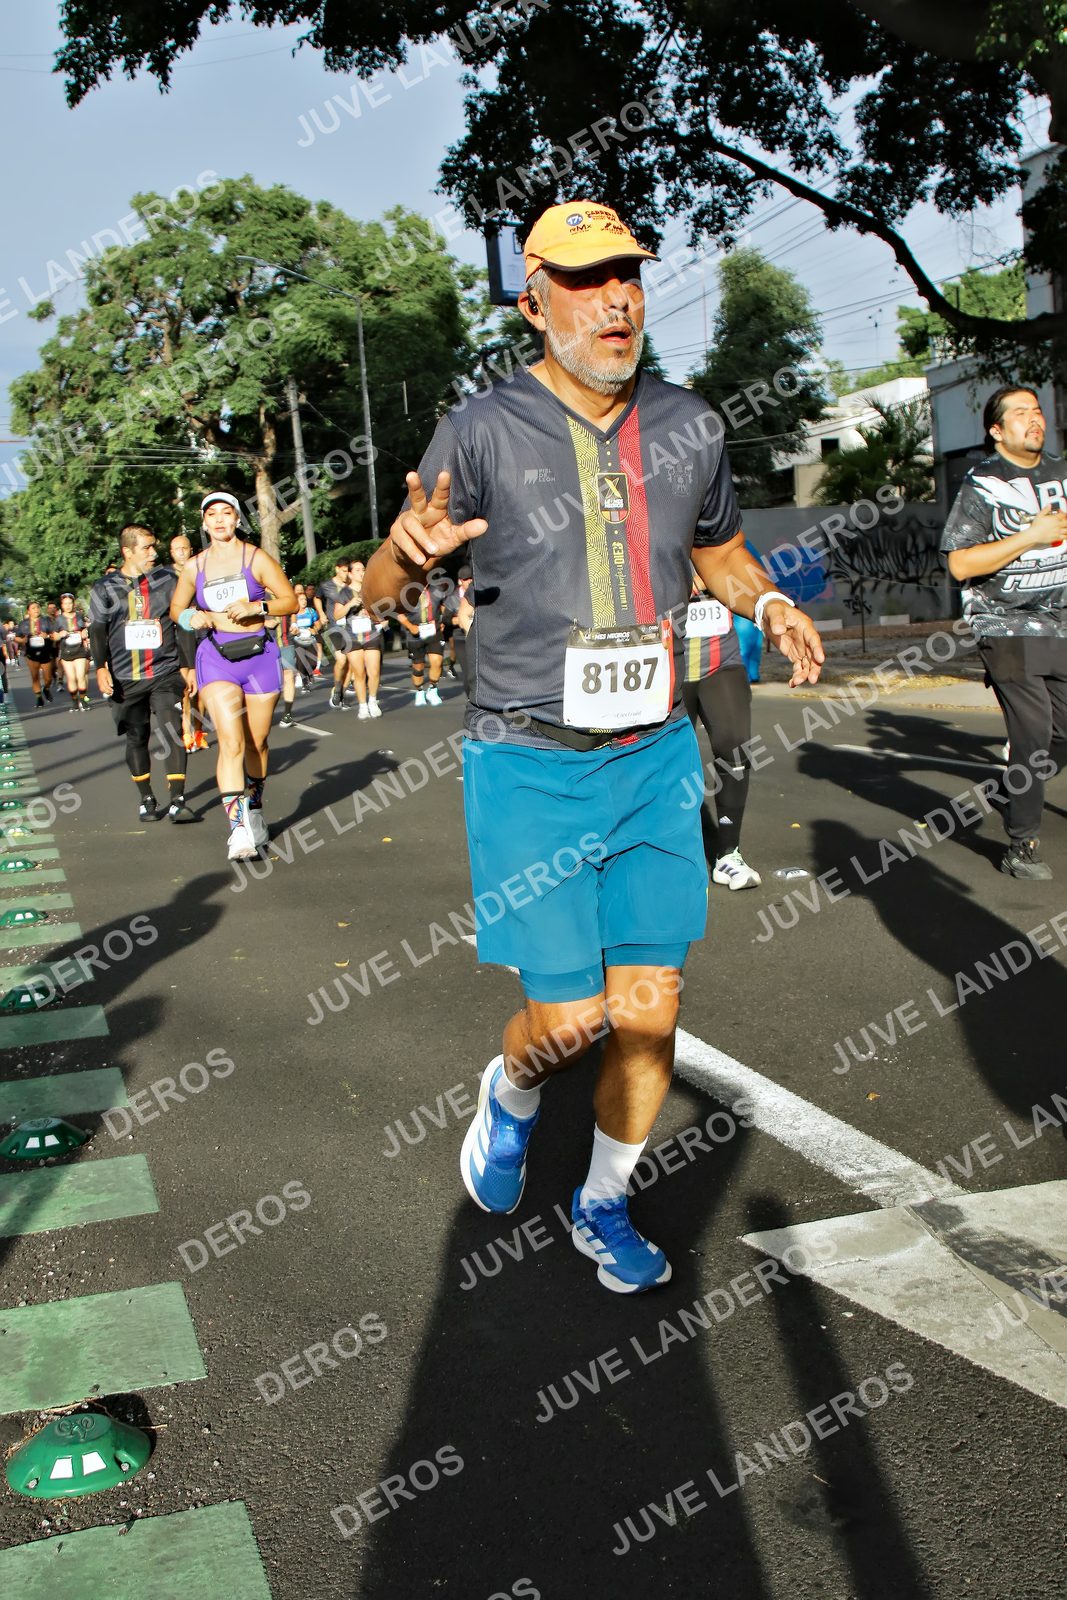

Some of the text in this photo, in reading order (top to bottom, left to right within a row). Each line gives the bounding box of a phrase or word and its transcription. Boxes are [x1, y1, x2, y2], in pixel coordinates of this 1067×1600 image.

[216, 586, 235, 600] 697
[690, 606, 722, 621] 8913
[582, 657, 659, 695] 8187
